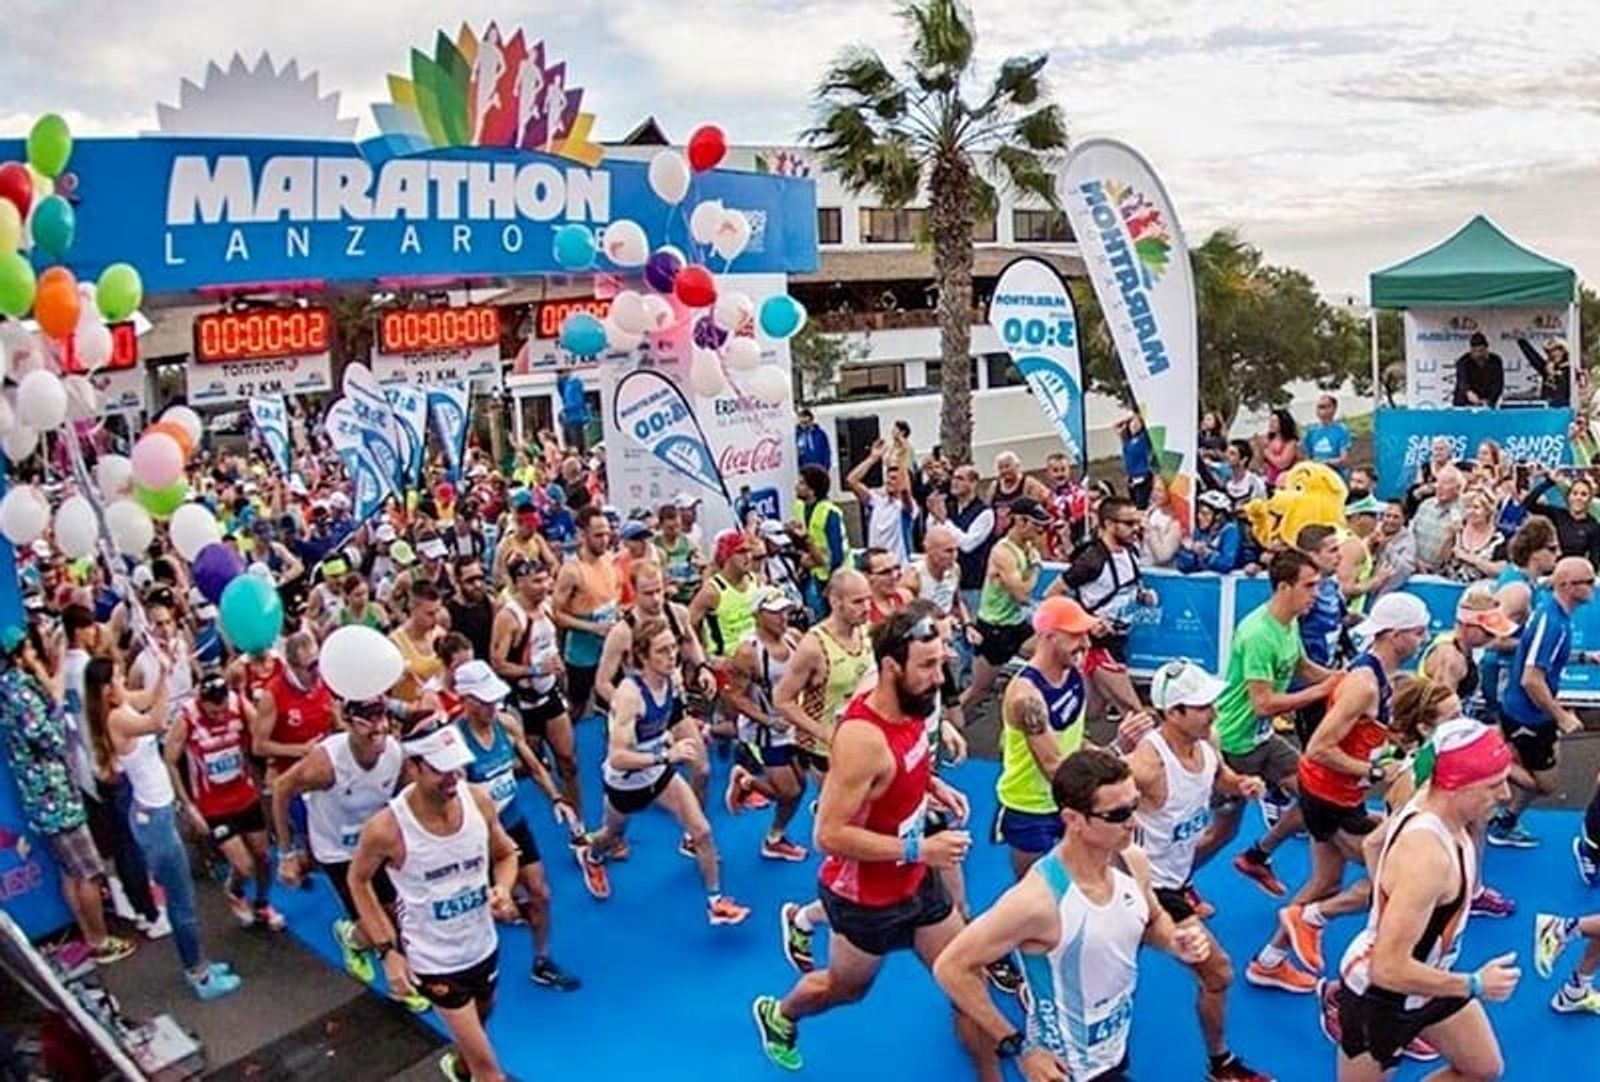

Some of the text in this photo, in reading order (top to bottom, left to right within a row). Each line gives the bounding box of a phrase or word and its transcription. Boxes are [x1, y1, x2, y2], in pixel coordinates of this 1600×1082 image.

[165, 155, 611, 225] MARATHON
[165, 224, 607, 264] LANZAROE
[202, 313, 325, 356] 00:00:02
[385, 309, 496, 349] 00:00:00
[238, 382, 254, 397] 42
[259, 379, 282, 393] KM
[416, 370, 430, 383] 21
[437, 368, 457, 380] KM
[719, 438, 784, 477] Coca-Cola
[1407, 434, 1566, 451] SADS SANDS
